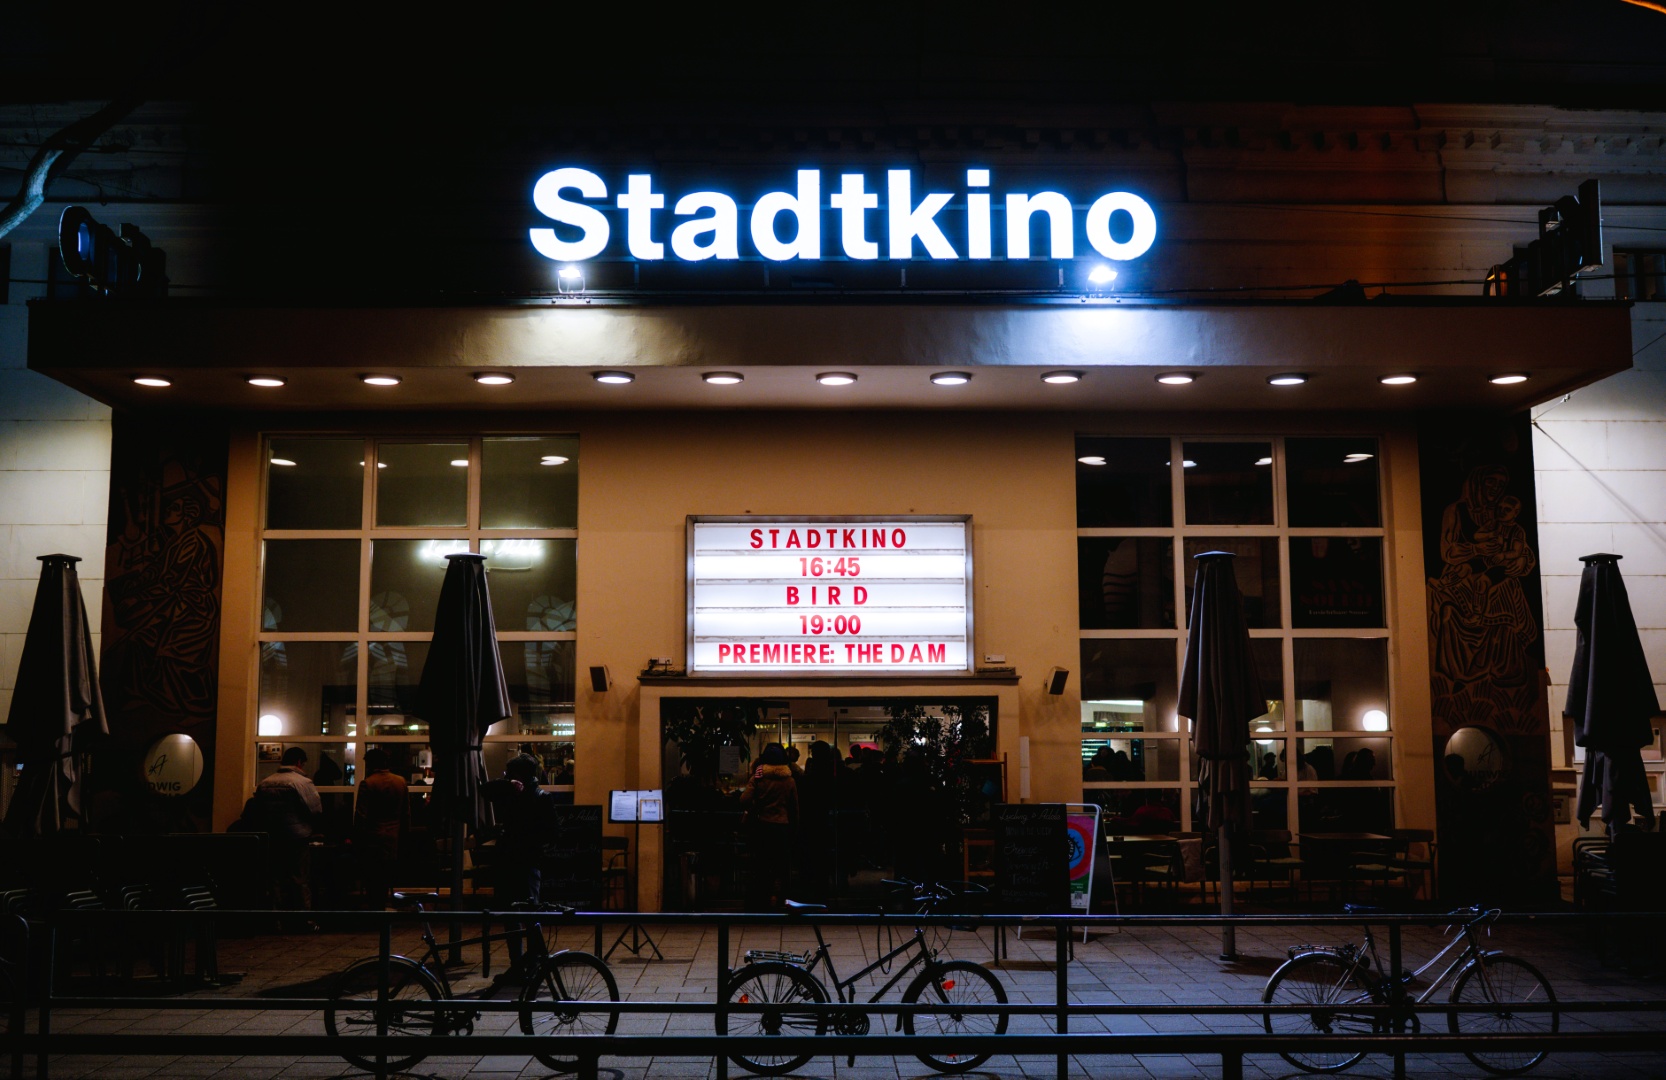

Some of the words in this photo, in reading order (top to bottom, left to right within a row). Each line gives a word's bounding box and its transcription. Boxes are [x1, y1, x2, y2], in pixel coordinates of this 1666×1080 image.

[529, 167, 1157, 262] Stadtkino
[749, 528, 907, 549] STADTKINO
[799, 557, 861, 577] 16:45
[786, 585, 869, 606] BIRD
[799, 614, 862, 635] 19:00
[718, 643, 835, 664] PREMIERE:
[844, 643, 883, 664] THE
[890, 643, 946, 664] DAM
